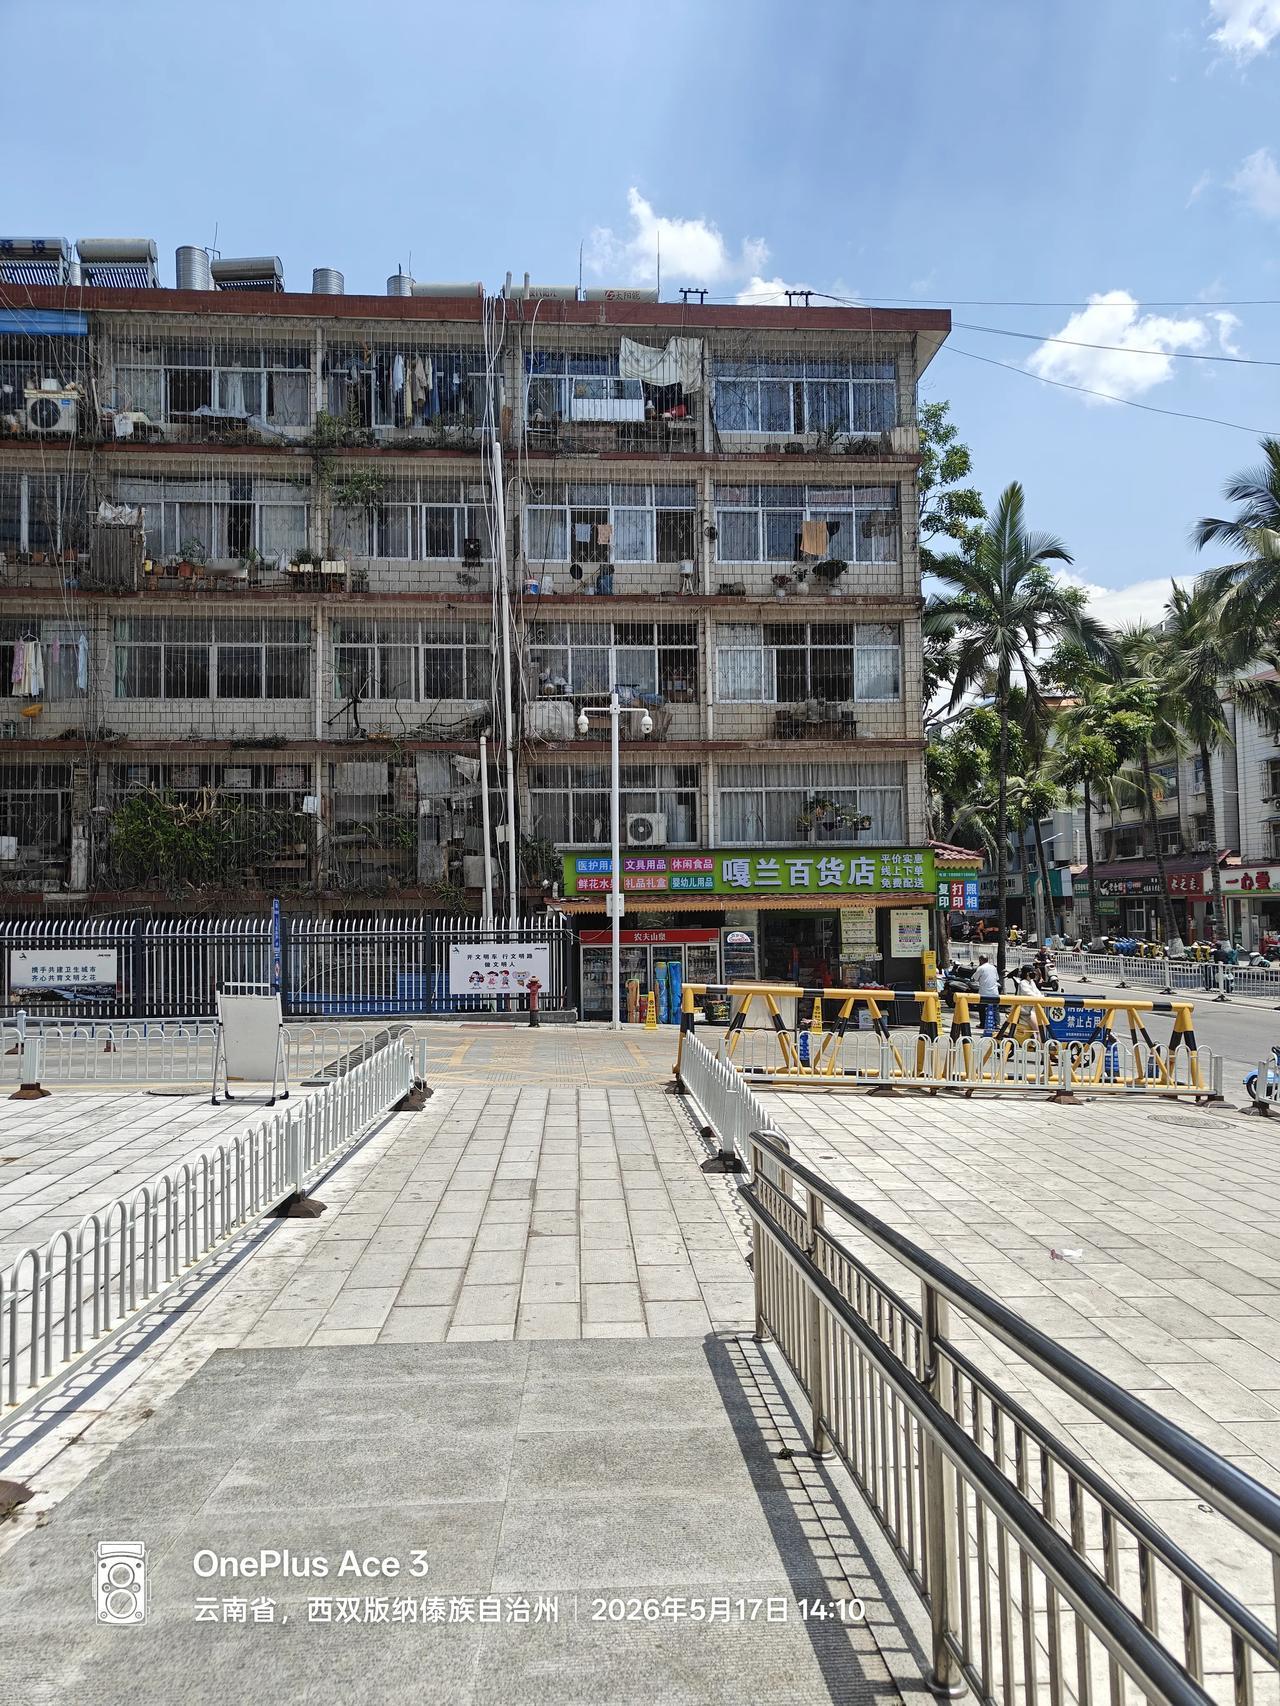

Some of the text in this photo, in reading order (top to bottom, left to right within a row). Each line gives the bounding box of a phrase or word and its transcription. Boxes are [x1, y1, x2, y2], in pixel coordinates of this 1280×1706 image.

[880, 853, 924, 864] 平价实惠
[578, 860, 612, 871] 医护用
[625, 859, 667, 870] 文具用品
[672, 859, 713, 870] 休闲食品
[722, 856, 876, 888] 嘎兰百货店
[880, 865, 924, 876] 线上下单
[625, 878, 667, 889] 礼品礼盒
[672, 877, 714, 888] 婴幼儿用品
[880, 877, 925, 889] 免费配送
[938, 883, 950, 908] 复印
[952, 883, 964, 908] 打印
[966, 883, 978, 908] 照相
[633, 932, 666, 942] 农夫山泉
[31, 966, 97, 974] 携手共建卫生城市
[31, 974, 97, 982] 齐心共育文明之花
[1067, 1015, 1101, 1028] 禁止占用
